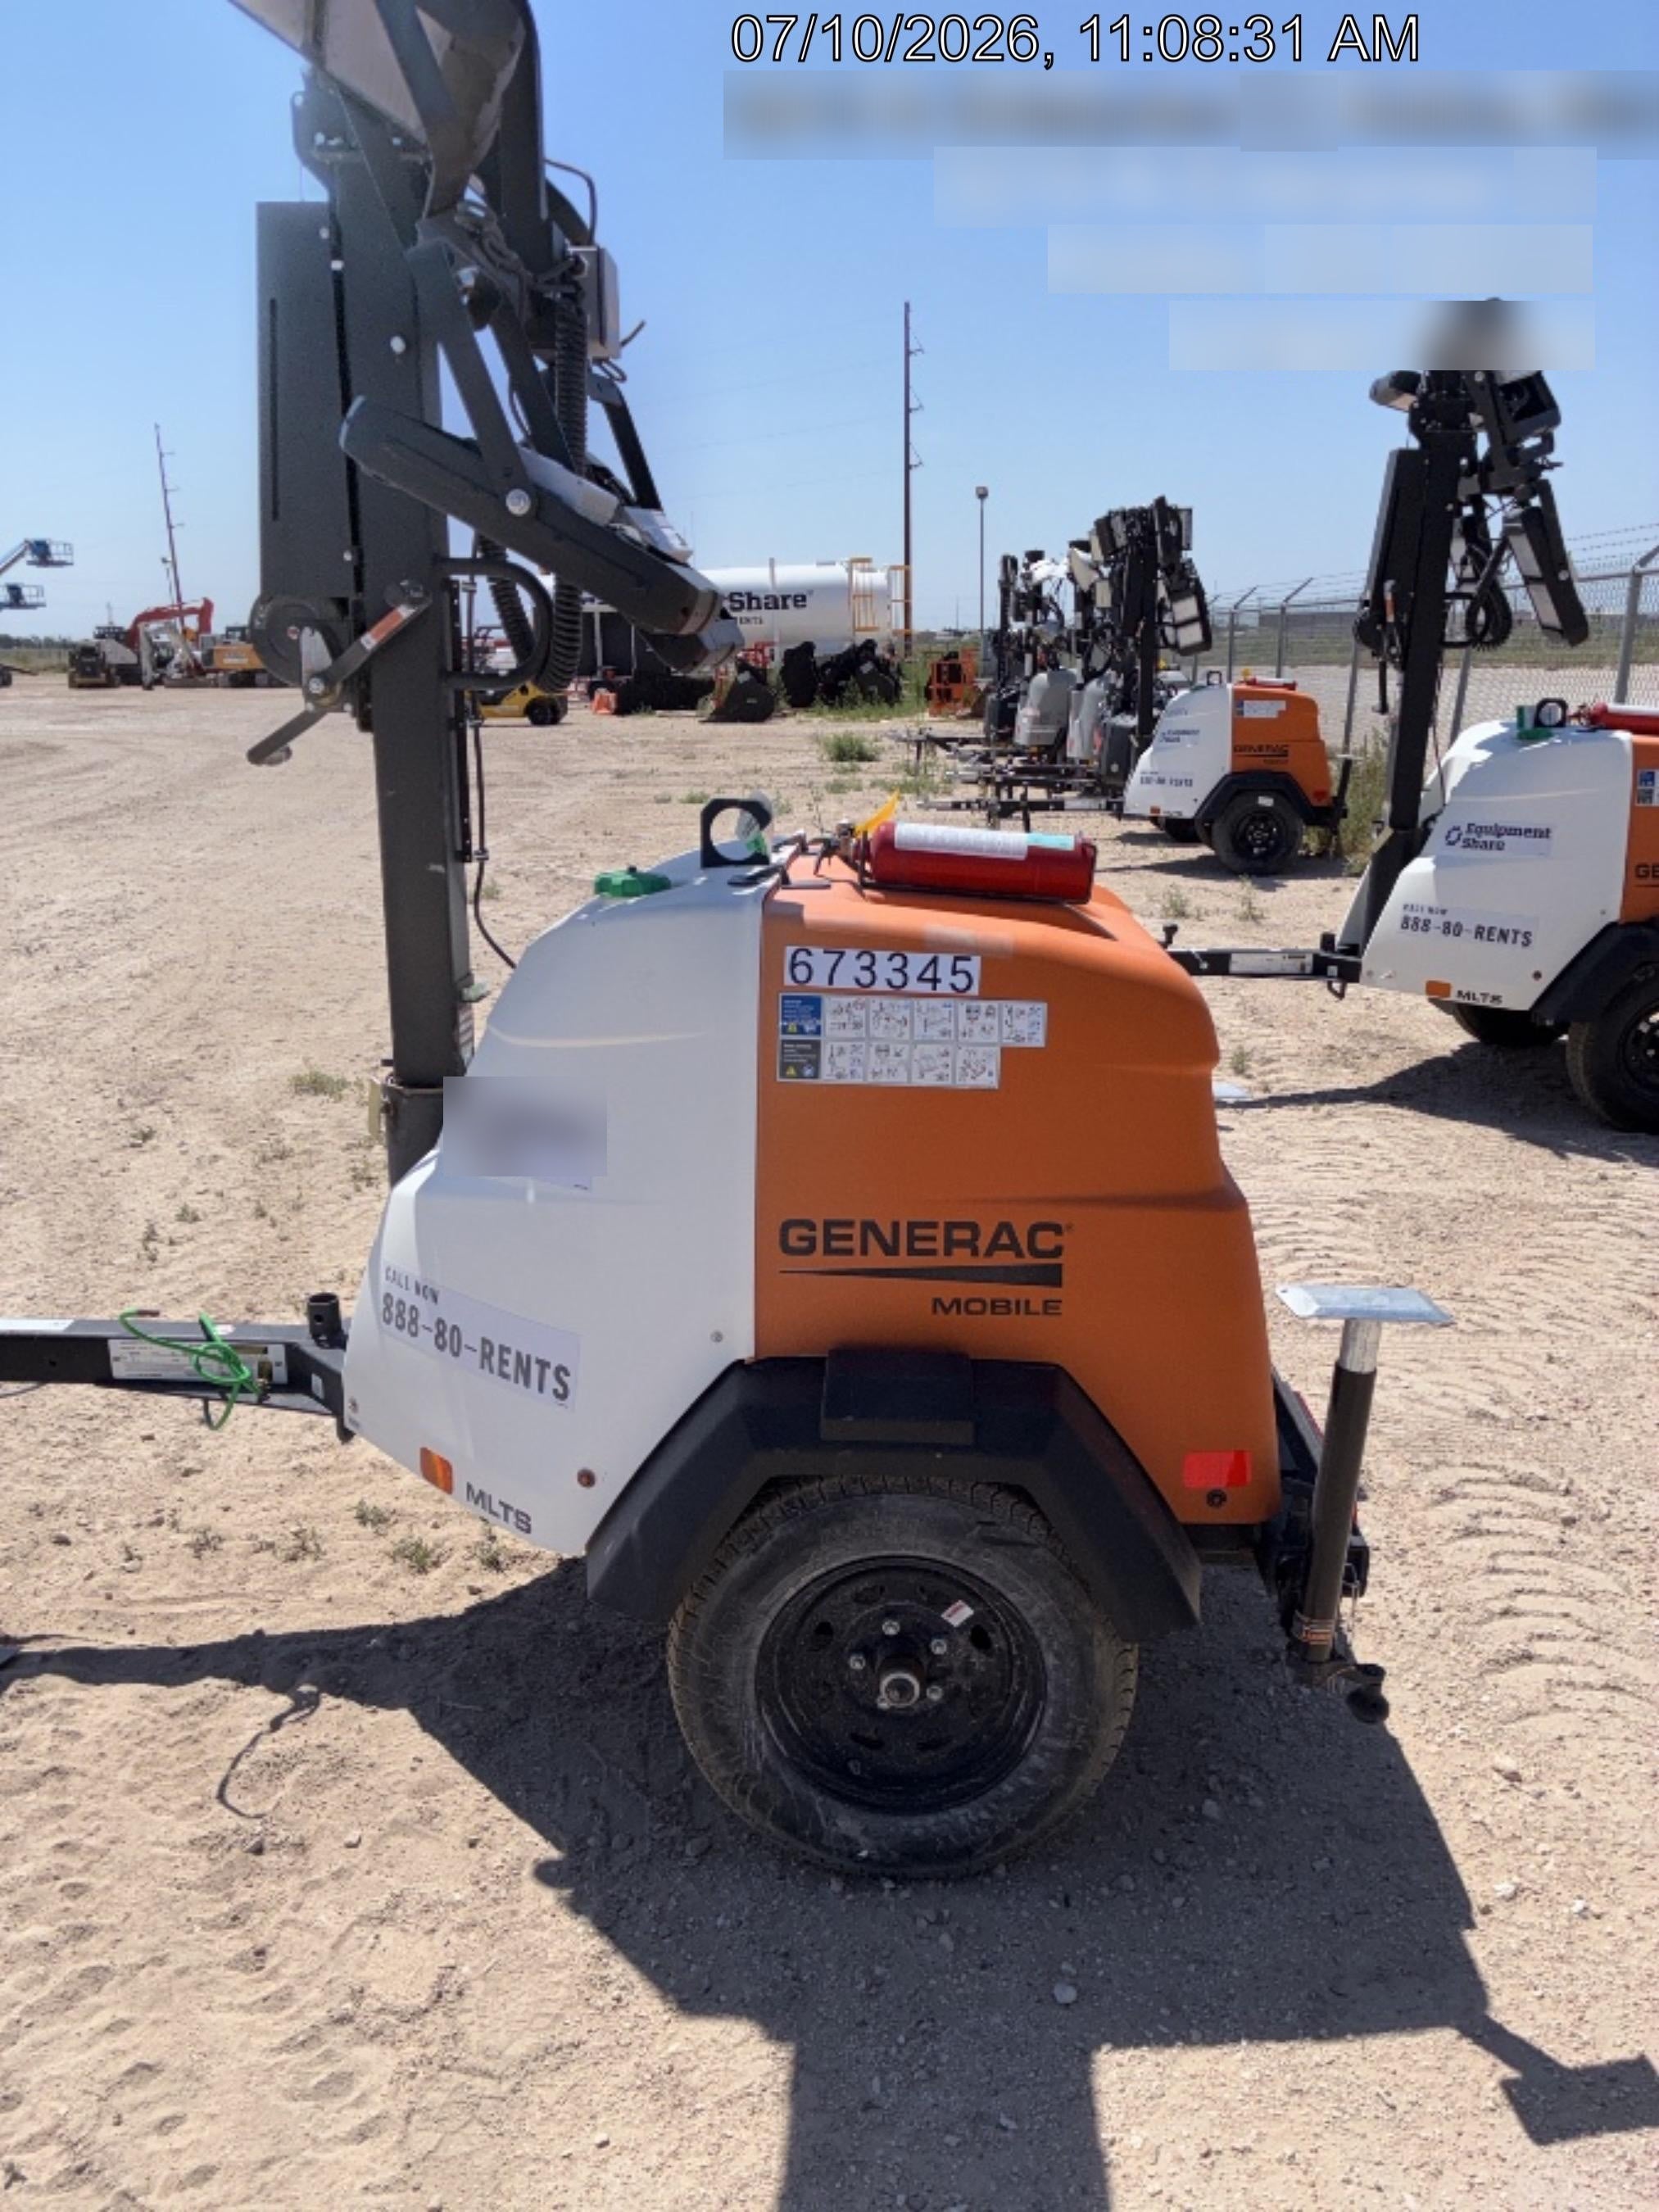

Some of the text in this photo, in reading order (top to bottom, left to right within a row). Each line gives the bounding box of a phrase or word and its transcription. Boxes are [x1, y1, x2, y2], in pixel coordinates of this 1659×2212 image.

[724, 591, 807, 612] Share
[1462, 837, 1506, 851] Share
[1465, 823, 1552, 839] Equipment
[1400, 914, 1533, 948] 888-80-RENTS
[788, 947, 974, 994] 673345
[1456, 990, 1503, 1005] MLTS
[779, 1218, 1063, 1259] GENERAC
[385, 1266, 440, 1304] CALL NOW
[931, 1297, 1063, 1317] MOBILE
[382, 1293, 572, 1403] 888-80-RENTS
[465, 1481, 533, 1535] MLTS
